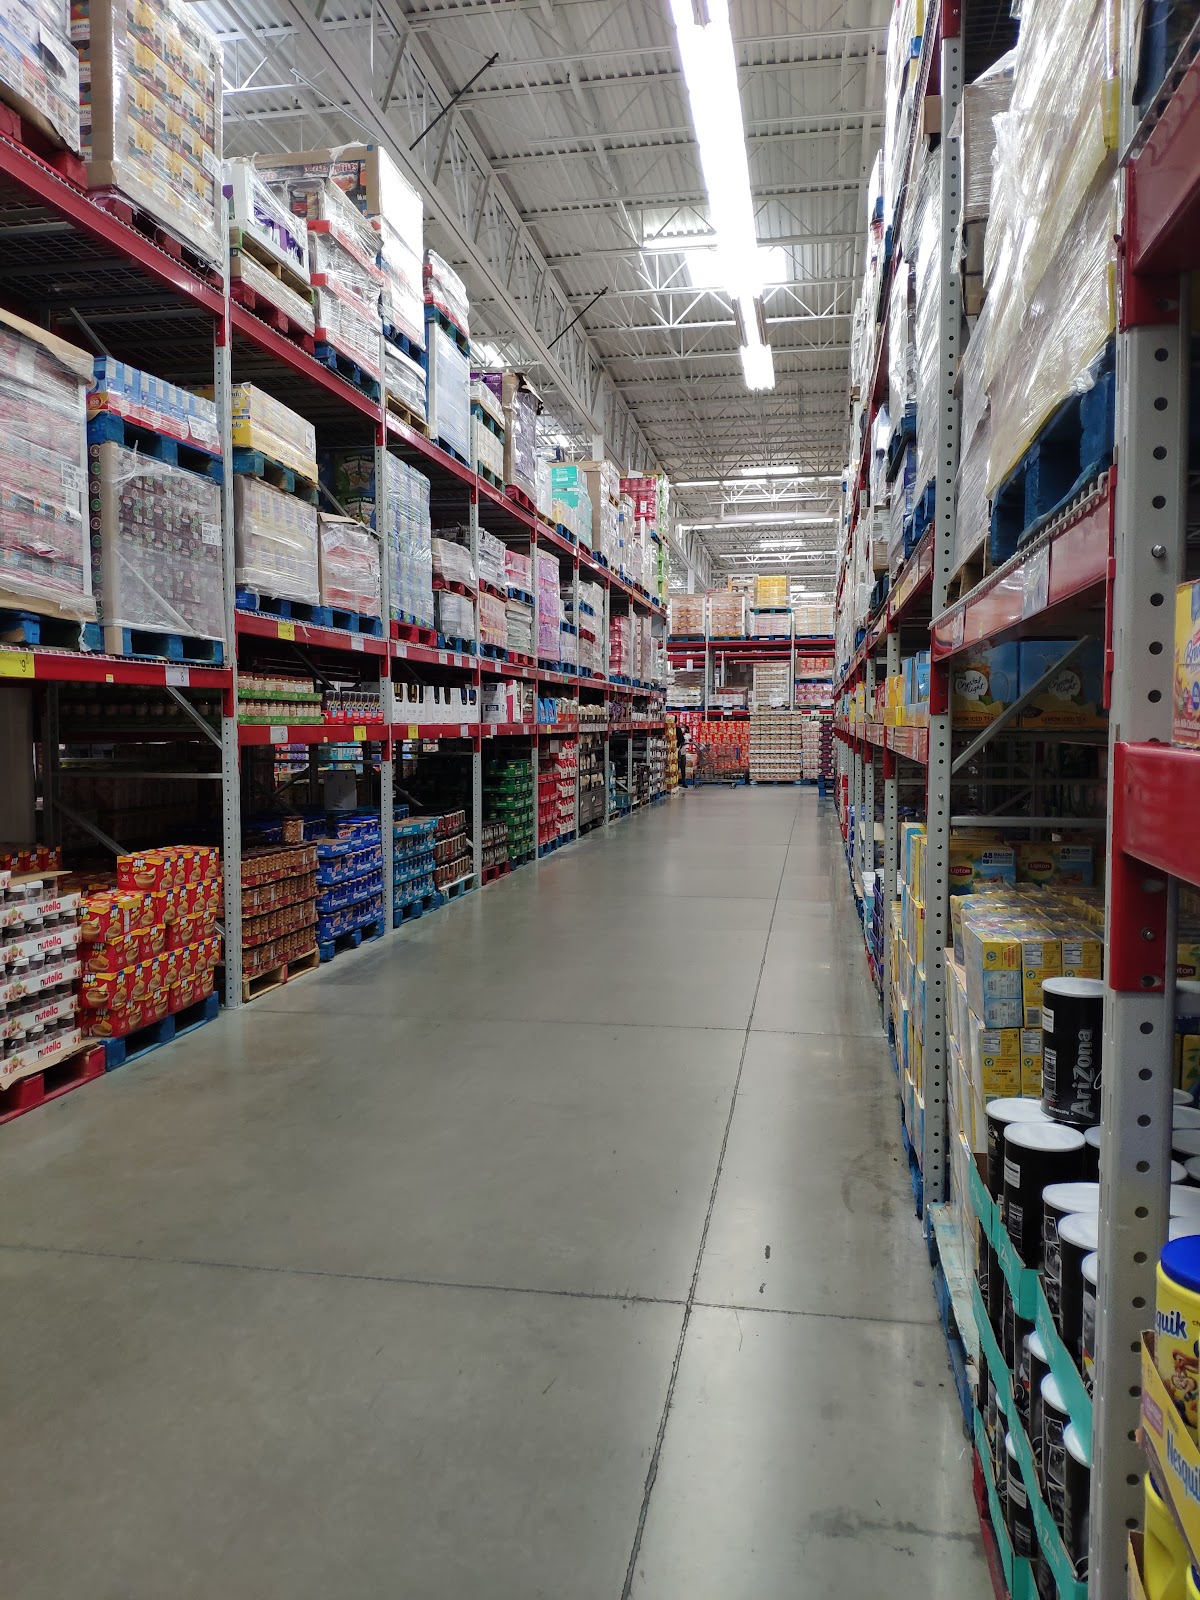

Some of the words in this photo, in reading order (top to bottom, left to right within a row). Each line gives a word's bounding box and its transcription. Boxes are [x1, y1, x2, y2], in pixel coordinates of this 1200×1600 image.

[957, 676, 983, 691] Crystal
[950, 867, 971, 875] Lipton
[1030, 862, 1050, 871] Lipton
[36, 901, 61, 915] nutella
[37, 936, 62, 951] nutella
[40, 972, 63, 988] nutella
[34, 1006, 59, 1023] nutella
[37, 1041, 62, 1059] nutella
[1070, 1028, 1095, 1119] AriZona
